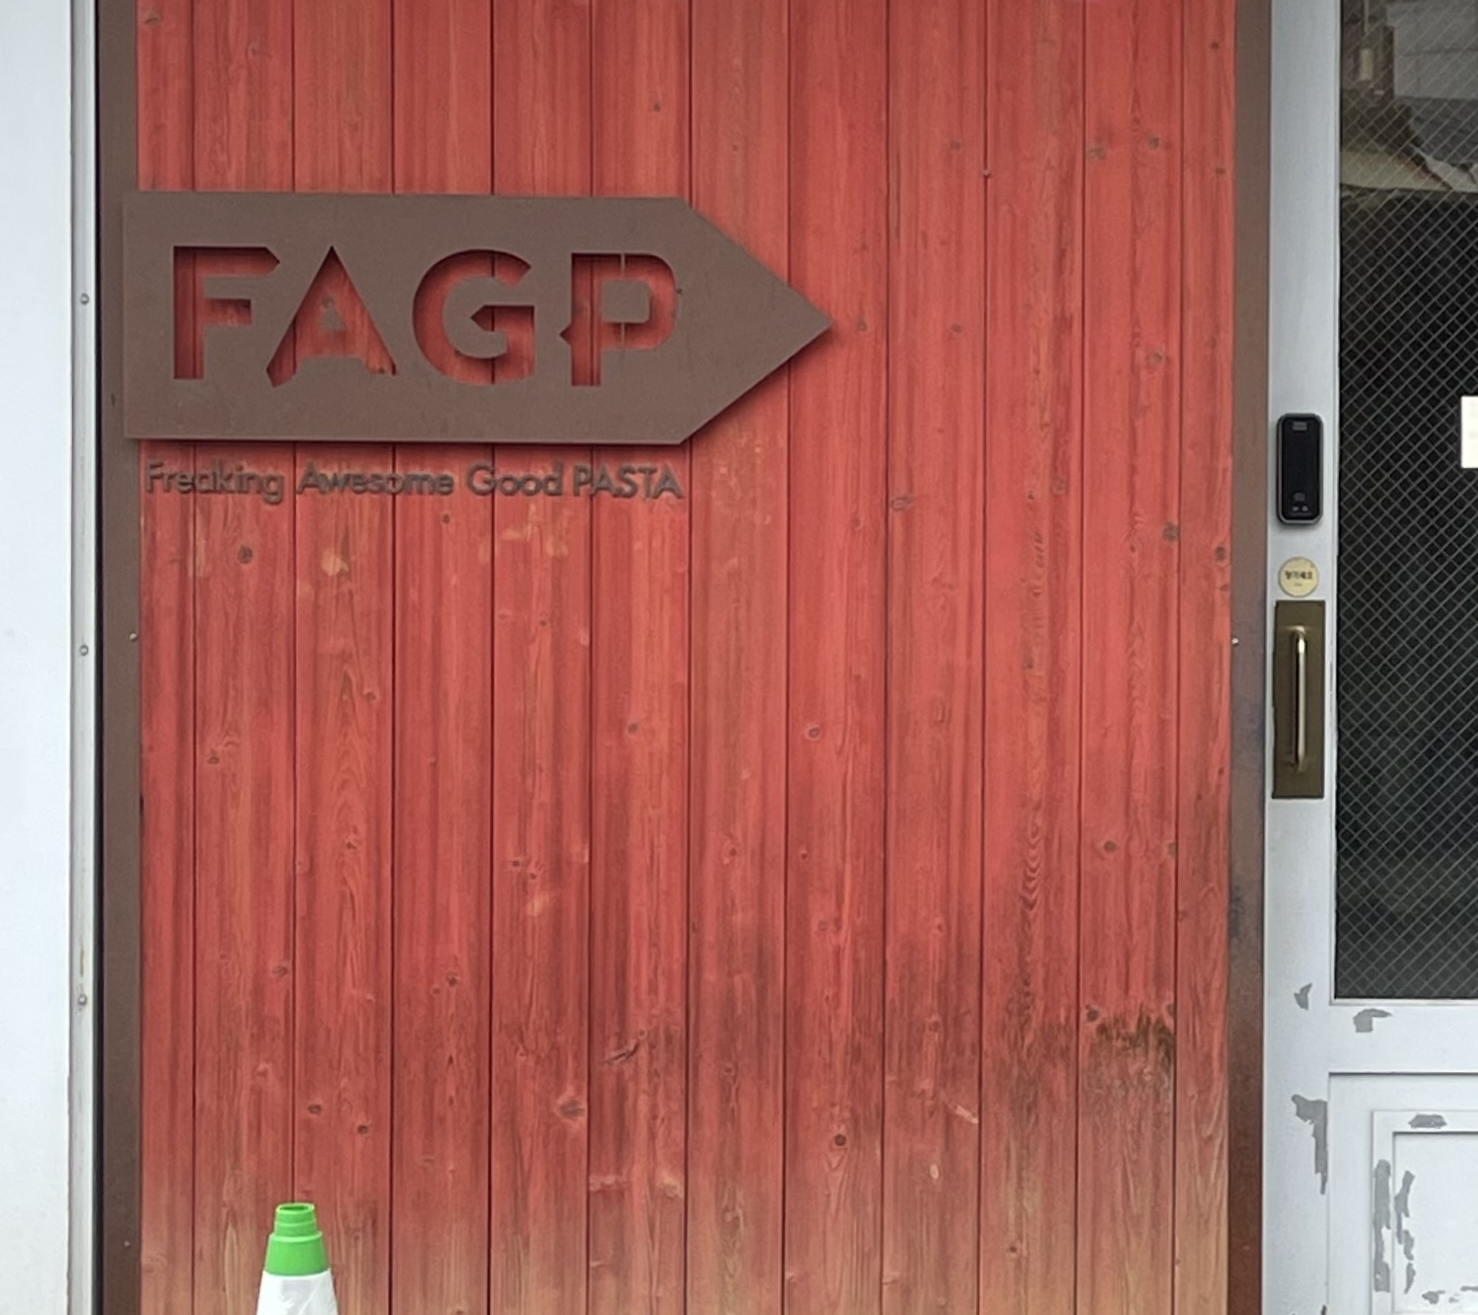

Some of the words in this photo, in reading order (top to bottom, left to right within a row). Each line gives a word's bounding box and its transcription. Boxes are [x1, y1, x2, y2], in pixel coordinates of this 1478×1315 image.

[173, 245, 680, 388] FAGP
[145, 462, 285, 504] Freaking
[296, 462, 455, 497] Awesome
[465, 462, 564, 498] Good
[573, 464, 683, 500] PASTA
